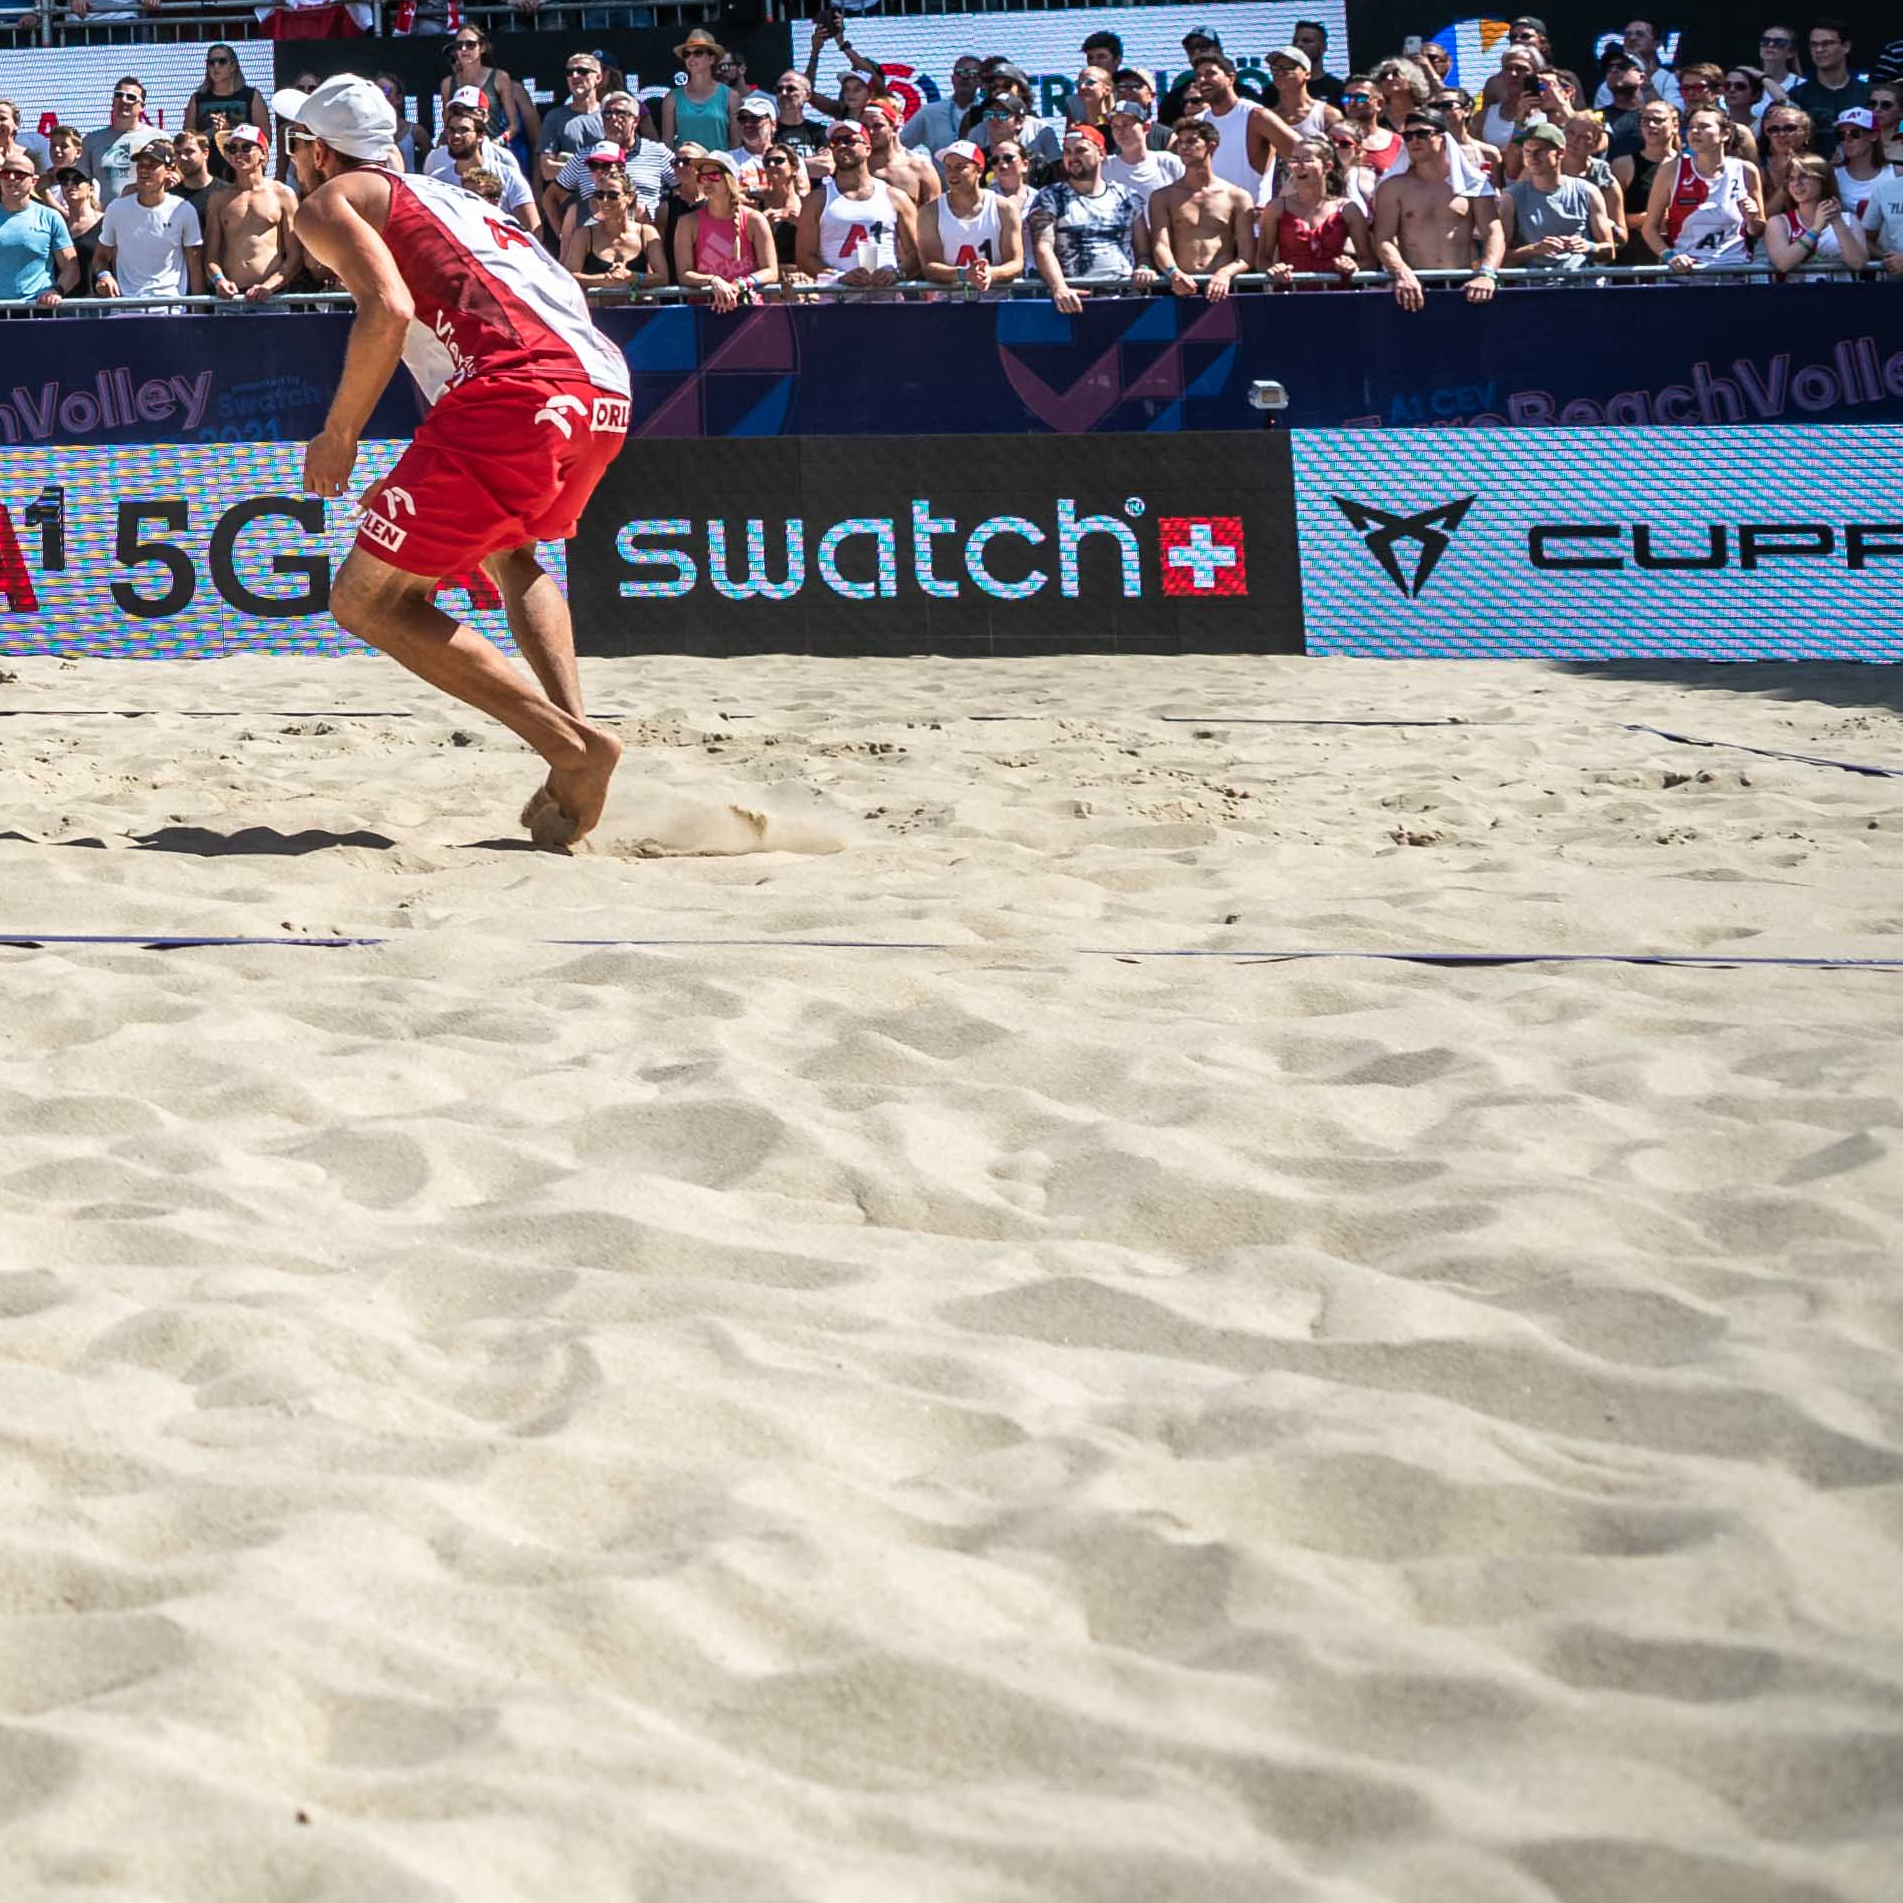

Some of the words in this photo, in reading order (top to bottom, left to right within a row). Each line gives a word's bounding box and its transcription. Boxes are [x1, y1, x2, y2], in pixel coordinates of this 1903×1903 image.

[839, 220, 888, 258] A1
[954, 238, 993, 266] A1
[109, 497, 333, 618] 5G
[615, 498, 1142, 601] swatch
